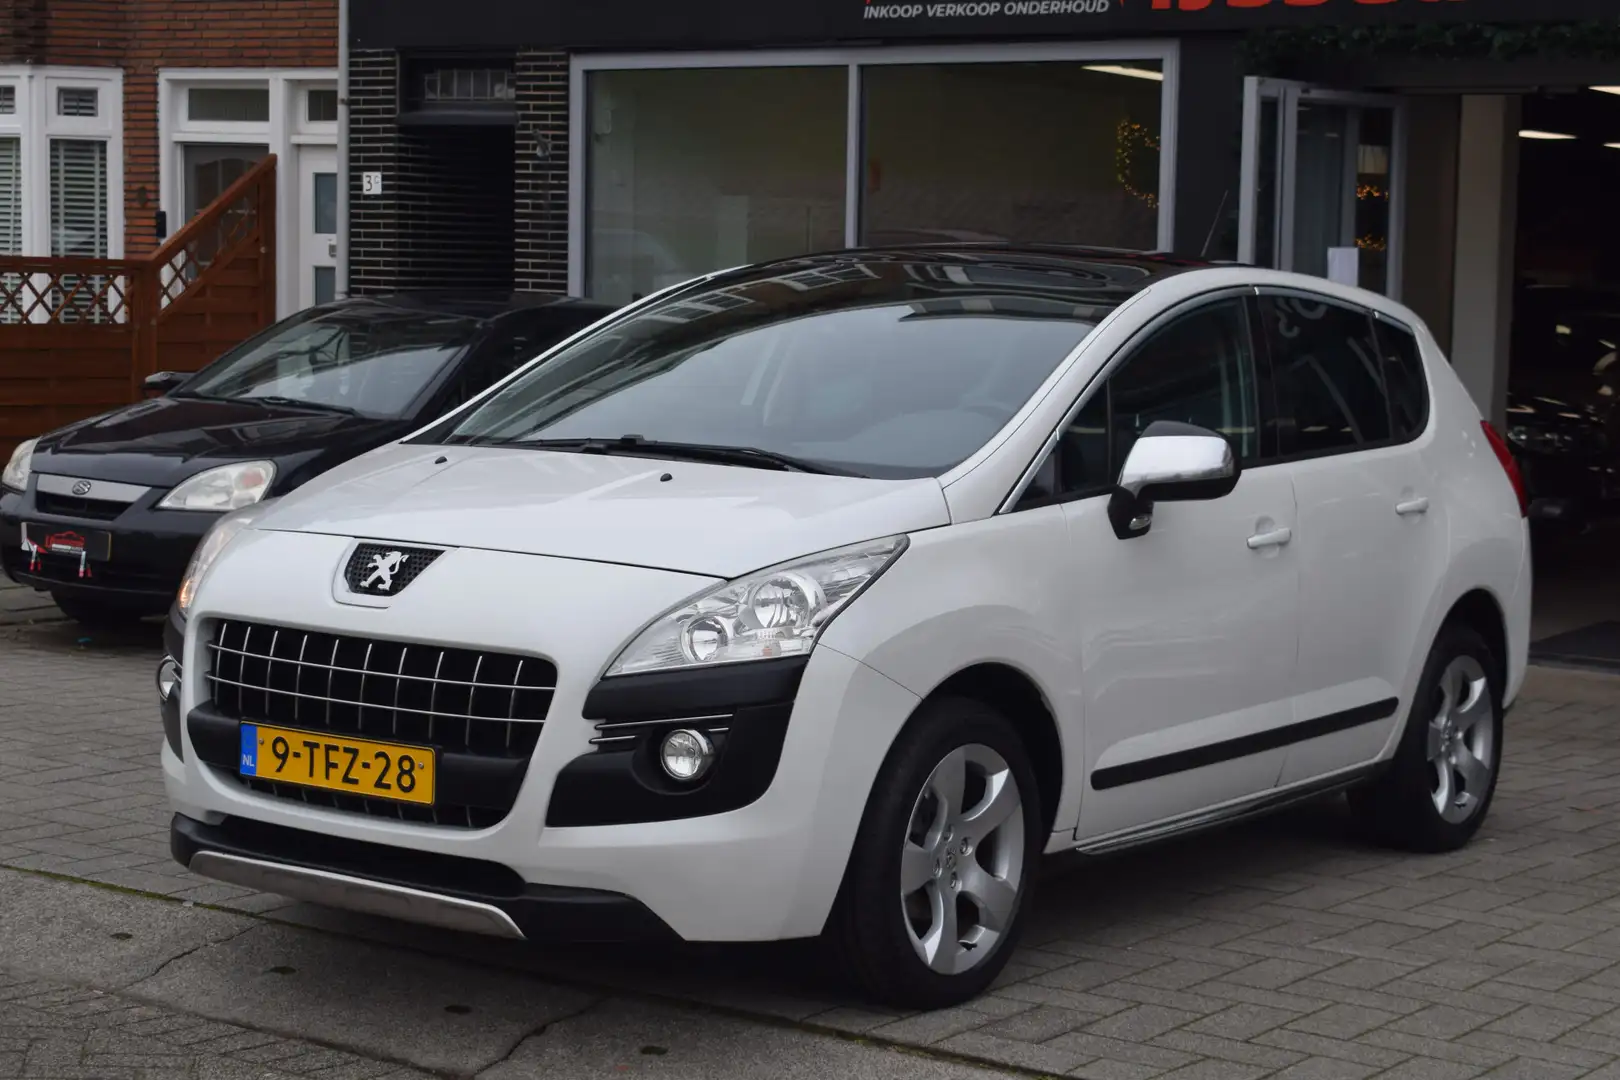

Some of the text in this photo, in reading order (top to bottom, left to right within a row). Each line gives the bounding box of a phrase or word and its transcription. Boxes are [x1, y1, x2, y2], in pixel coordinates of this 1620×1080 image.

[863, 0, 1110, 19] INKOOP VERKOOP ONDERHOUD
[242, 754, 255, 767] NL
[271, 736, 417, 793] 9-TFZ-28
